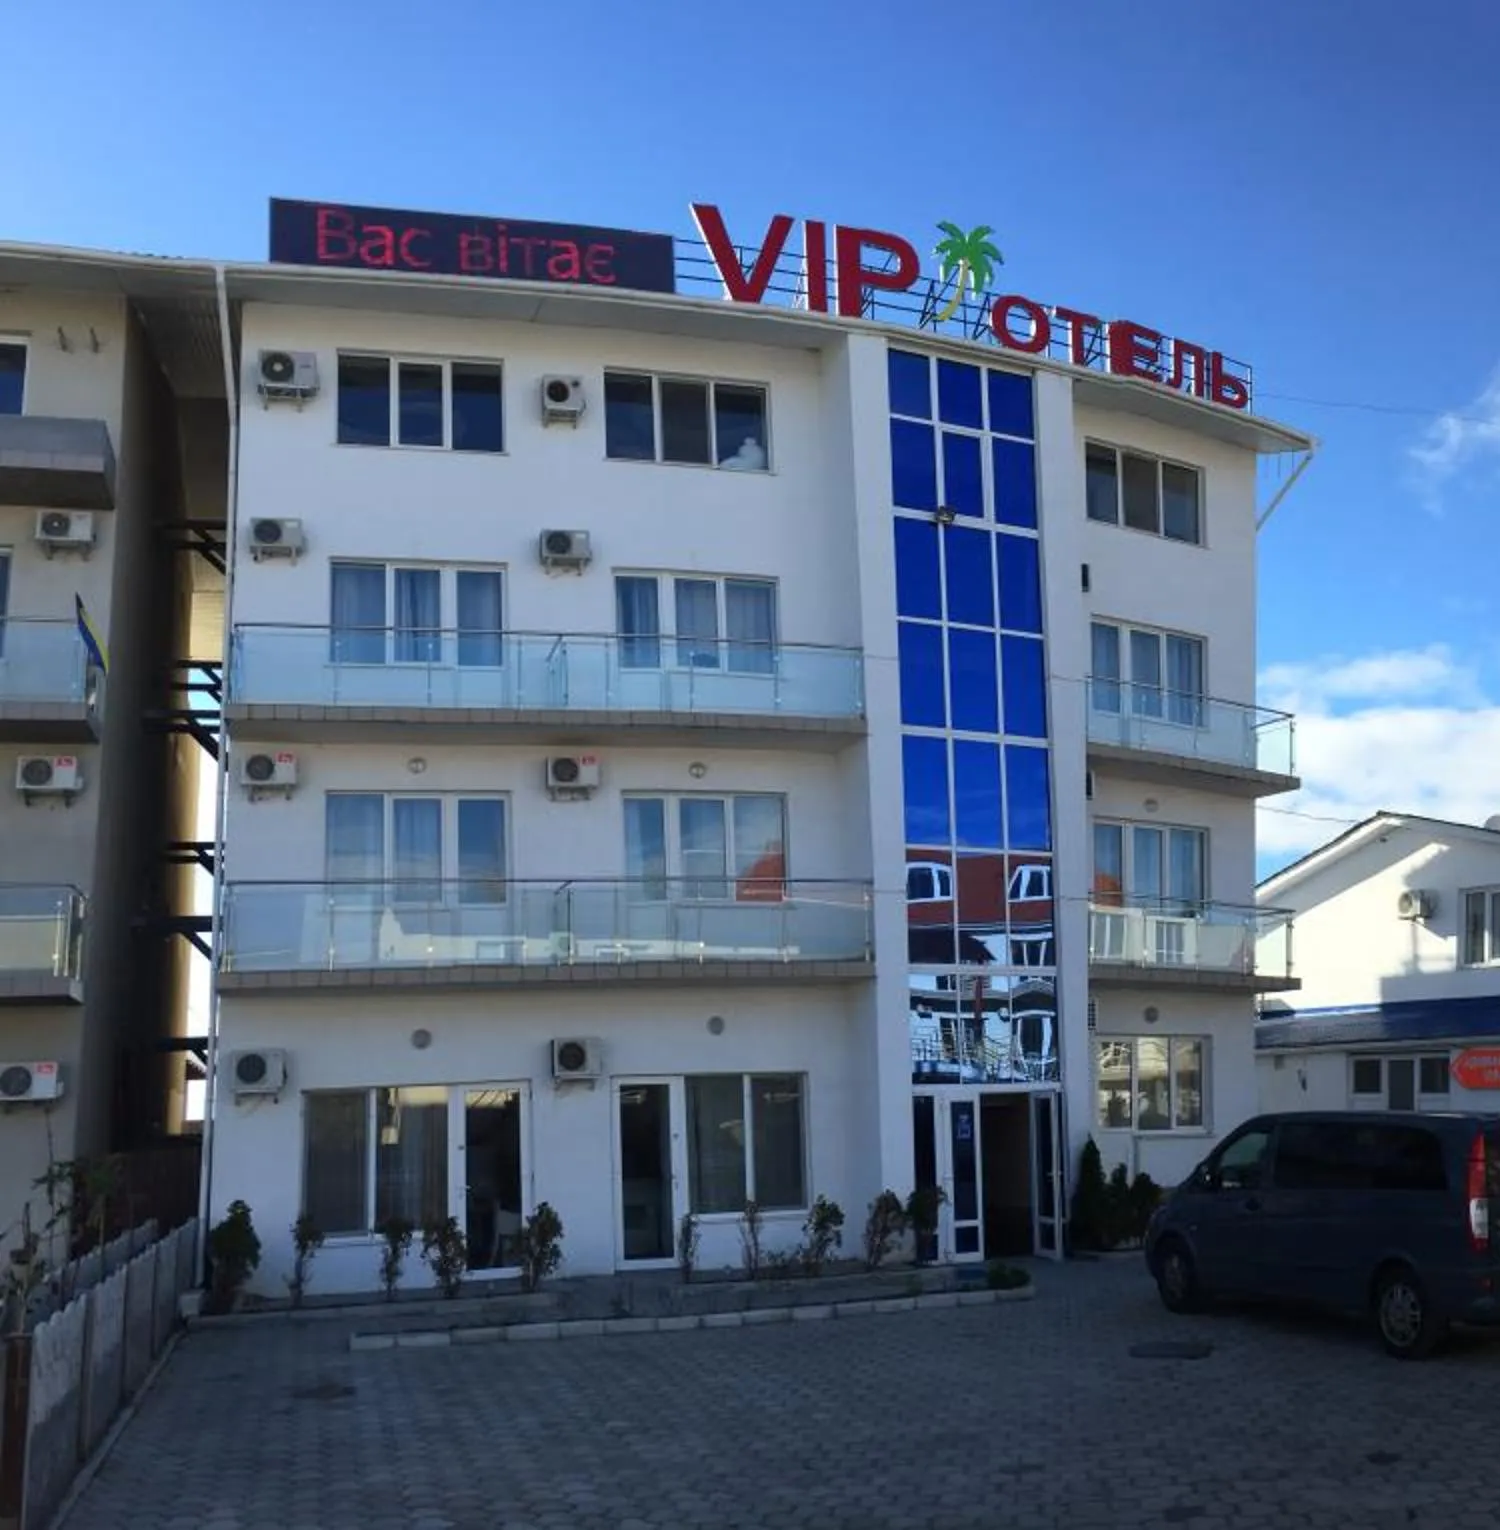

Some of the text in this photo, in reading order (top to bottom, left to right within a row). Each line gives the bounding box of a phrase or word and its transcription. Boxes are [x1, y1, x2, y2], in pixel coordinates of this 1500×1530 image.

[315, 206, 618, 284] Вас вітає
[689, 202, 921, 318] VIP
[988, 294, 1249, 409] ОТЕЛЬ
